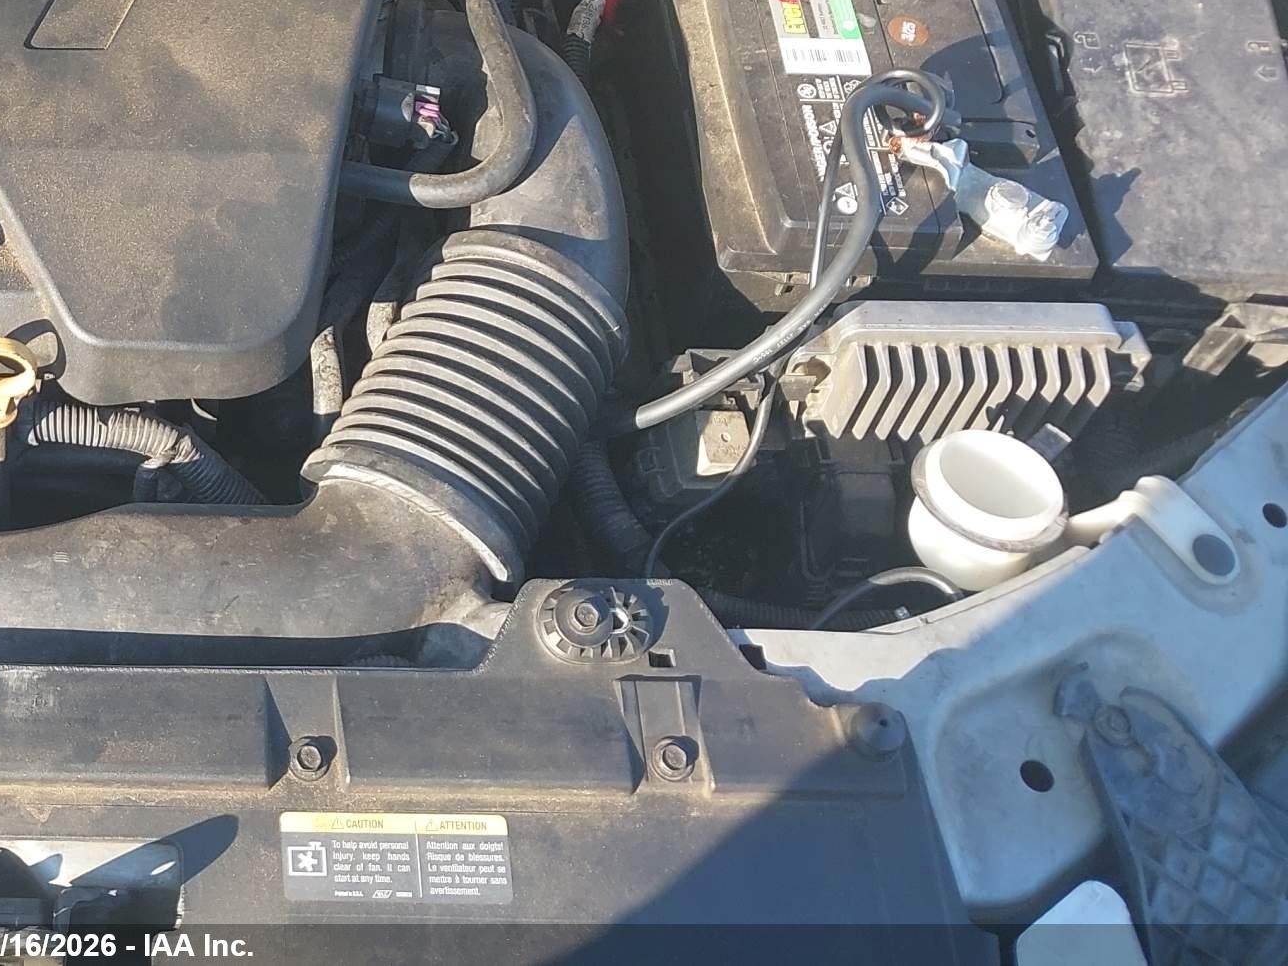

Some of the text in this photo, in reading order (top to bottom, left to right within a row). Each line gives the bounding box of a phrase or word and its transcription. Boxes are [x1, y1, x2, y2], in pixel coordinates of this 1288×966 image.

[346, 820, 383, 829] CAUTION
[440, 821, 486, 830] ATTENTION
[342, 840, 356, 850] help
[379, 842, 408, 850] personal
[426, 841, 458, 850] Attention
[480, 842, 503, 851] doigts!
[363, 852, 380, 861] keep
[388, 852, 410, 861] hands
[427, 852, 451, 861] Risque
[469, 853, 504, 862] blessures.
[334, 863, 351, 871] clear
[356, 863, 363, 871] of
[428, 863, 436, 872] Le
[440, 864, 476, 872] ventilateur
[479, 865, 494, 874] peut
[335, 875, 350, 883] start
[361, 876, 373, 884] any
[375, 875, 392, 883] time.
[463, 875, 487, 883] tourner
